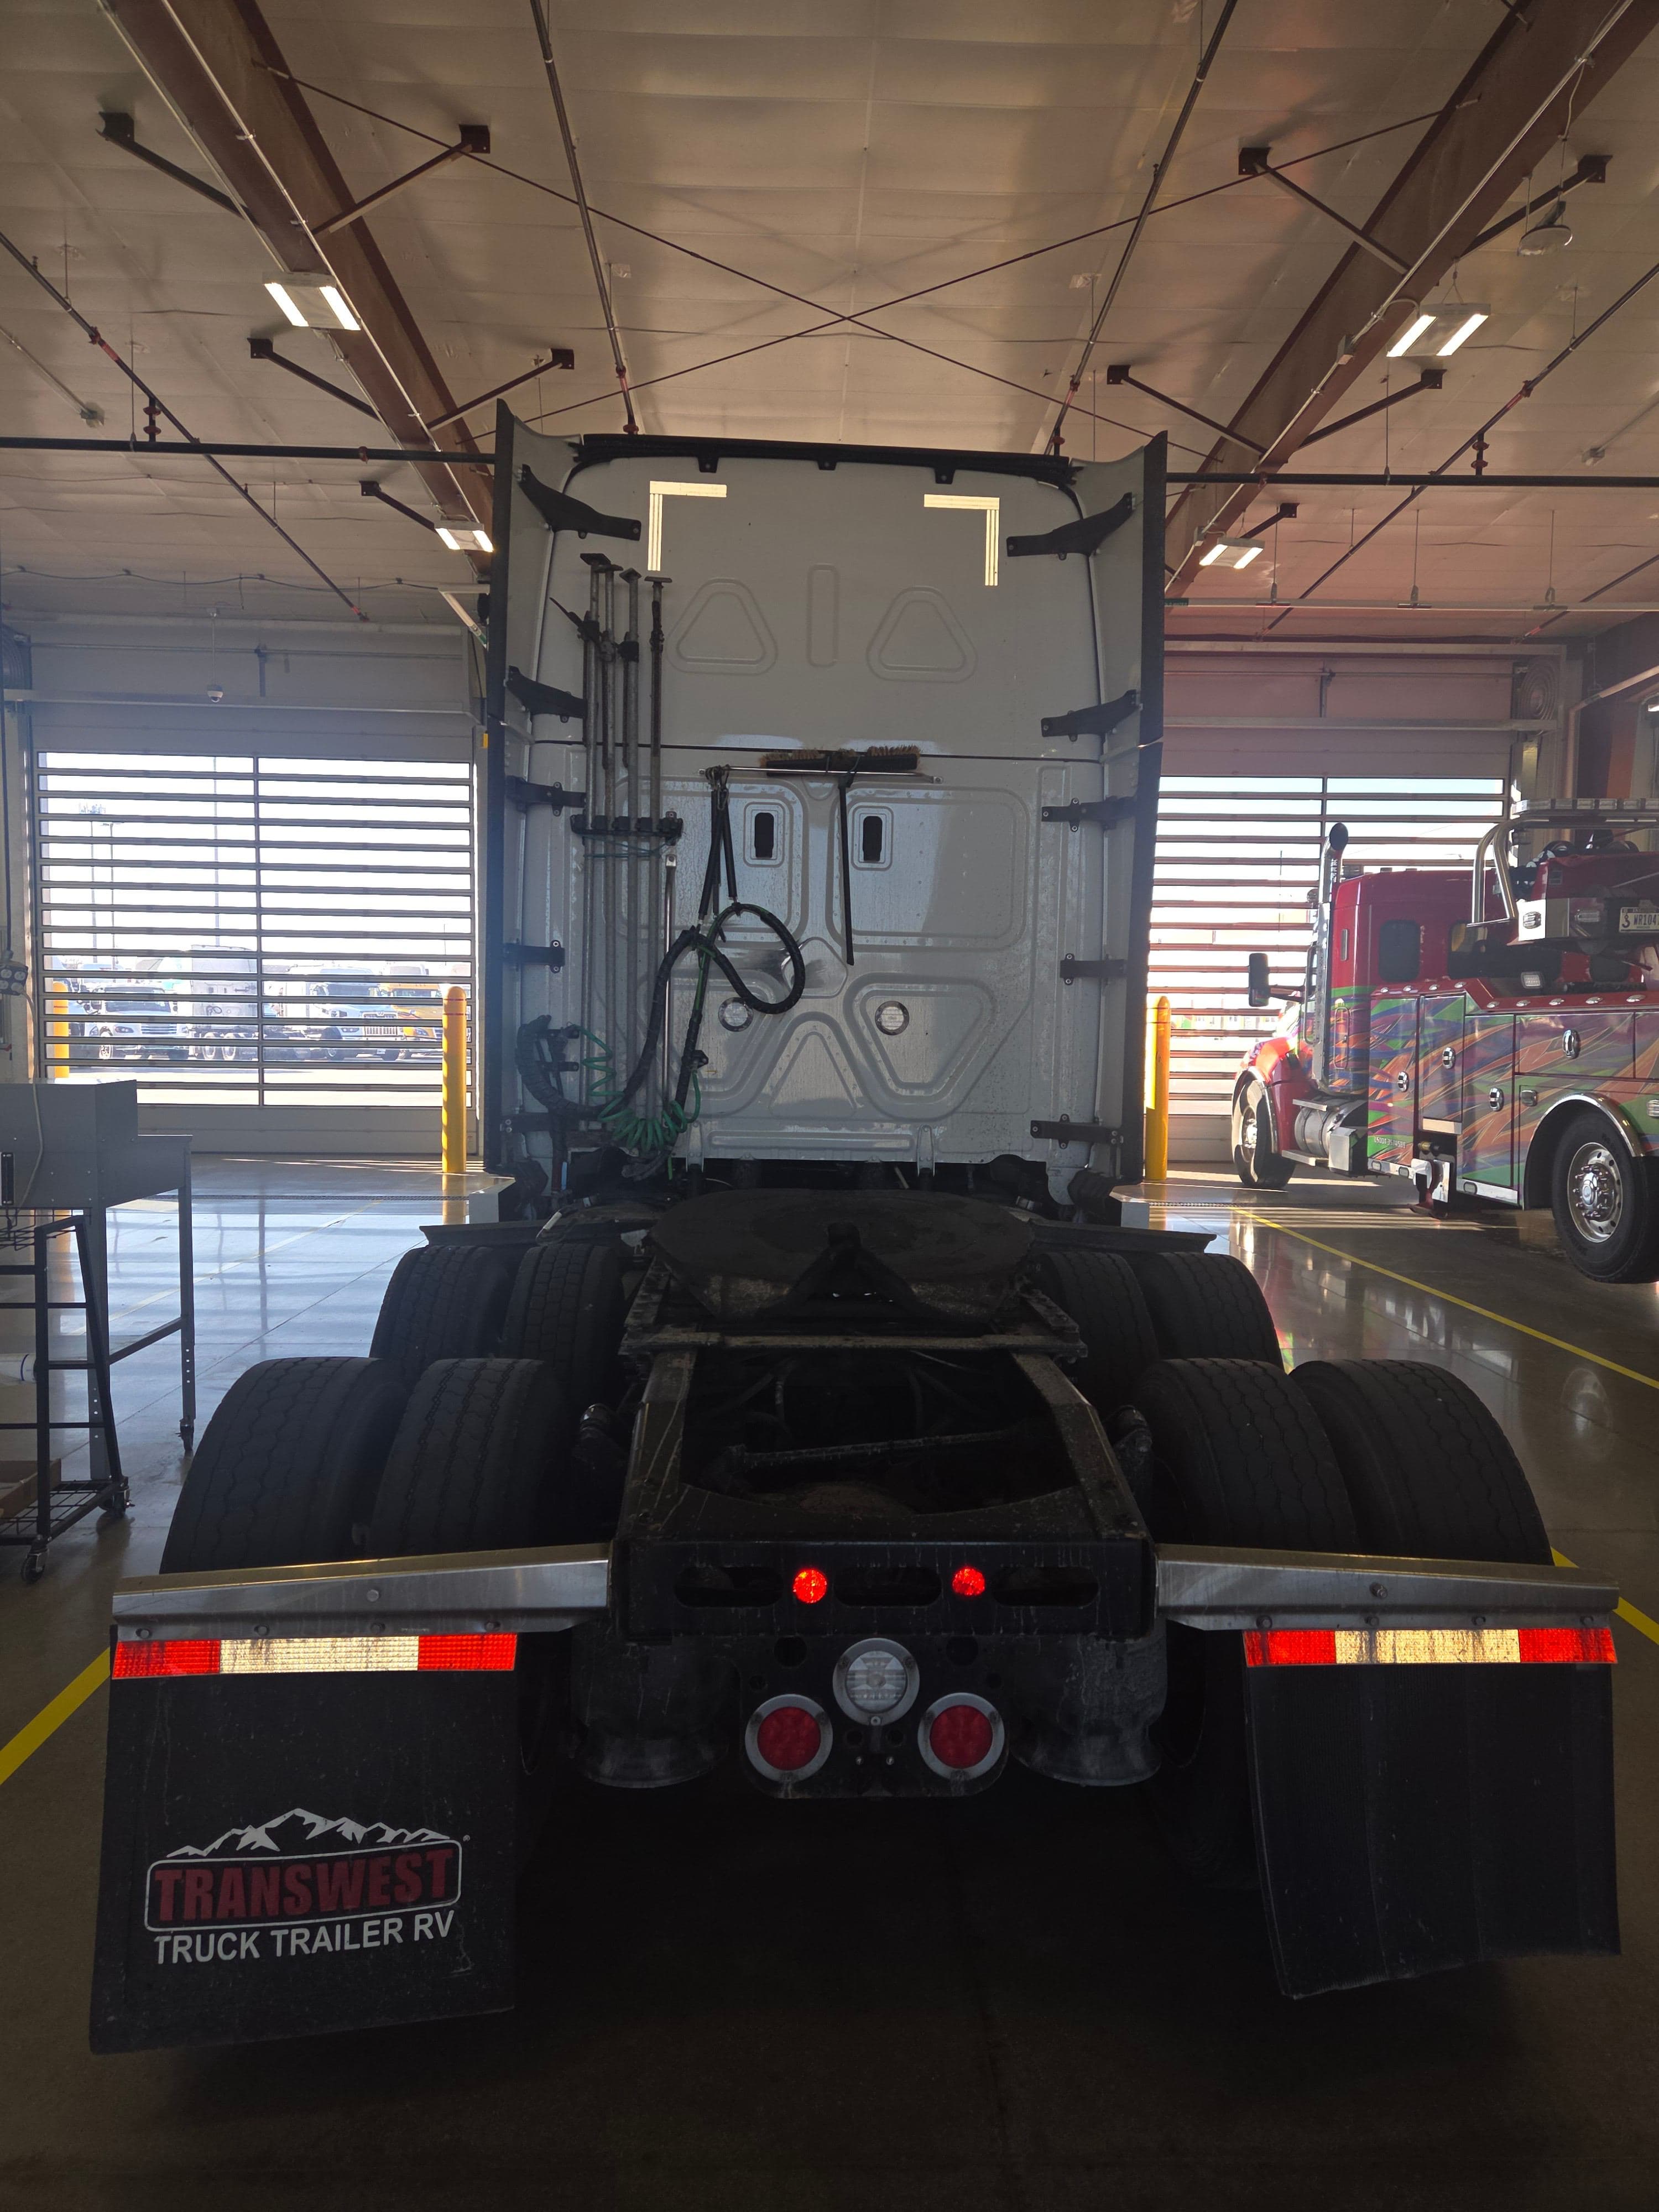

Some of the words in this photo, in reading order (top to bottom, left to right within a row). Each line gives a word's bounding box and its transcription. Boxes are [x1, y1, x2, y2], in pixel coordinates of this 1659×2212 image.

[1634, 914, 1659, 925] WR104
[154, 1849, 453, 1921] TRANSWEST
[154, 1931, 260, 1965] TRUCK
[270, 1917, 404, 1957] TRAILER
[414, 1910, 455, 1942] RV
